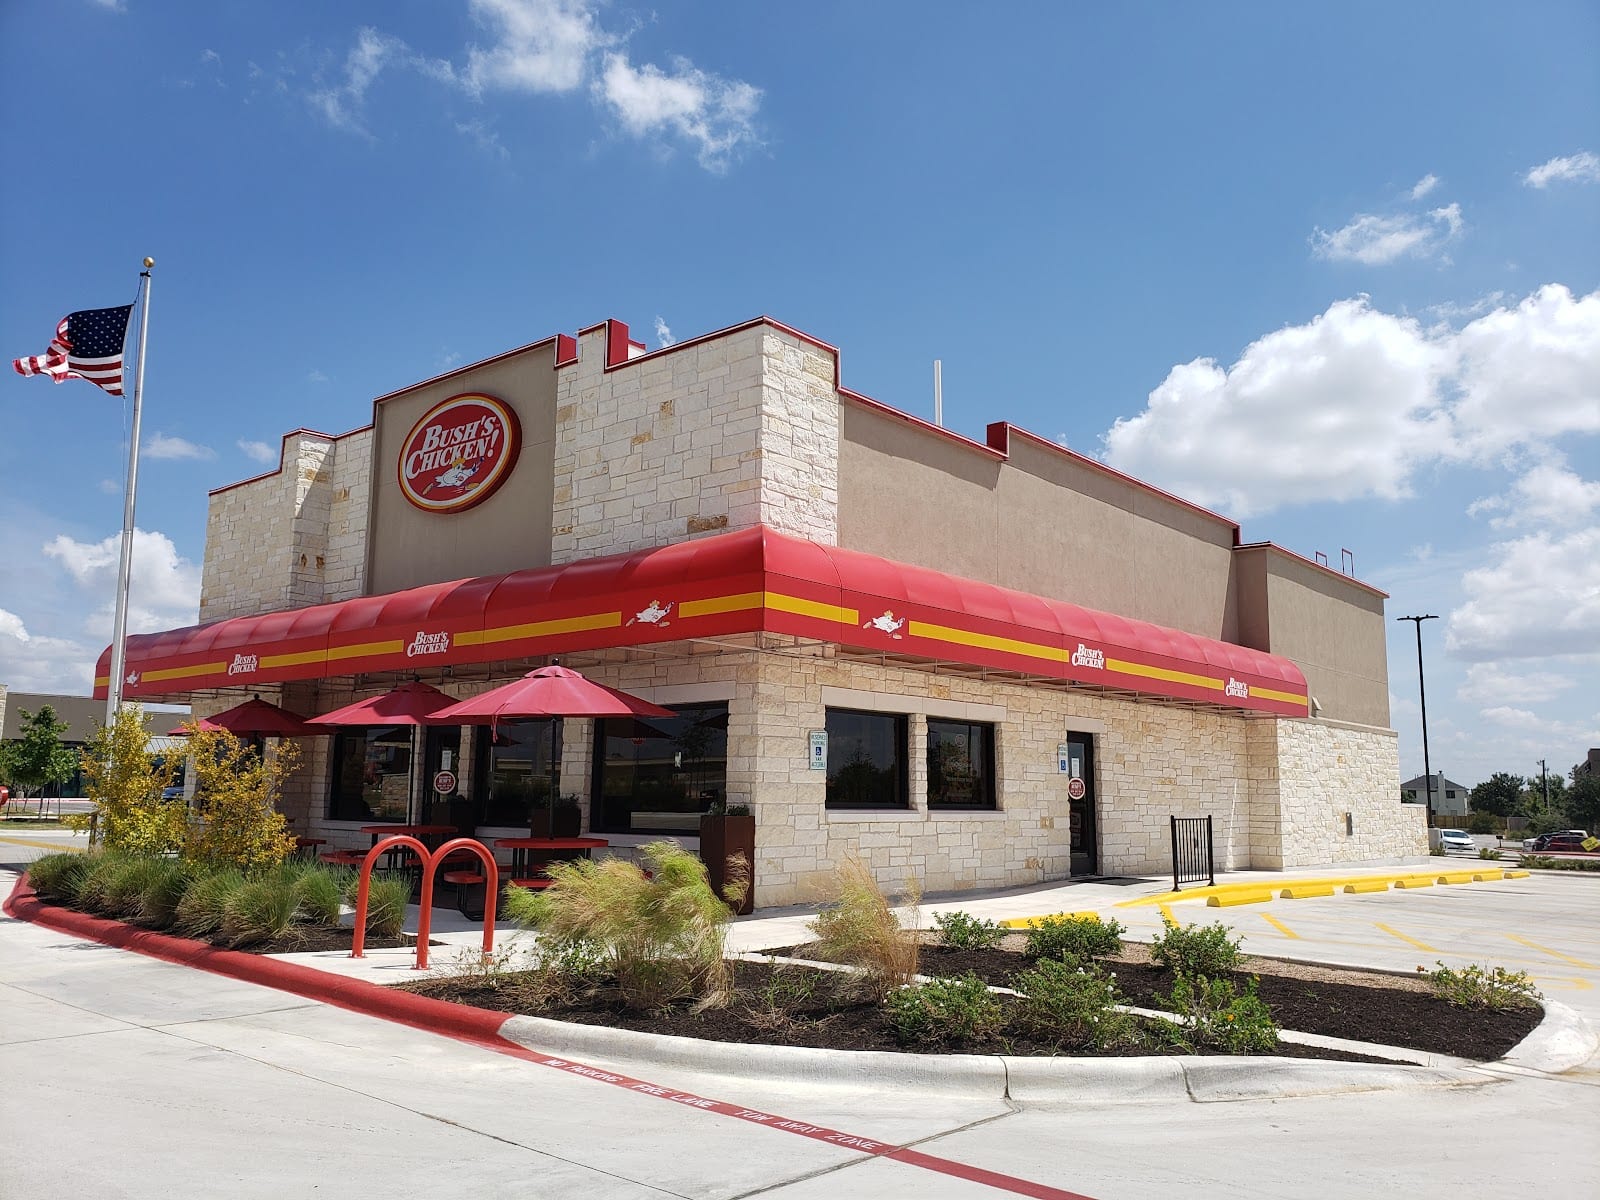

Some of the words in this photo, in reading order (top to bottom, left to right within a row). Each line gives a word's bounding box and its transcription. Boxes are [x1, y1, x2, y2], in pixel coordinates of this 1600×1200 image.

[421, 415, 497, 455] BUSH'S
[406, 429, 500, 479] CHICKEN!
[415, 631, 448, 645] BUSH'S
[407, 639, 449, 658] CHICKEN!
[1077, 643, 1103, 659] BUSH'S
[233, 653, 257, 666] BUSH'S
[1071, 652, 1104, 670] CHICKEN!
[631, 1084, 673, 1096] FIRE
[670, 1094, 720, 1108] LANE
[735, 1109, 774, 1121] TOW
[773, 1120, 825, 1134] AWAY
[823, 1133, 883, 1150] ZONE
